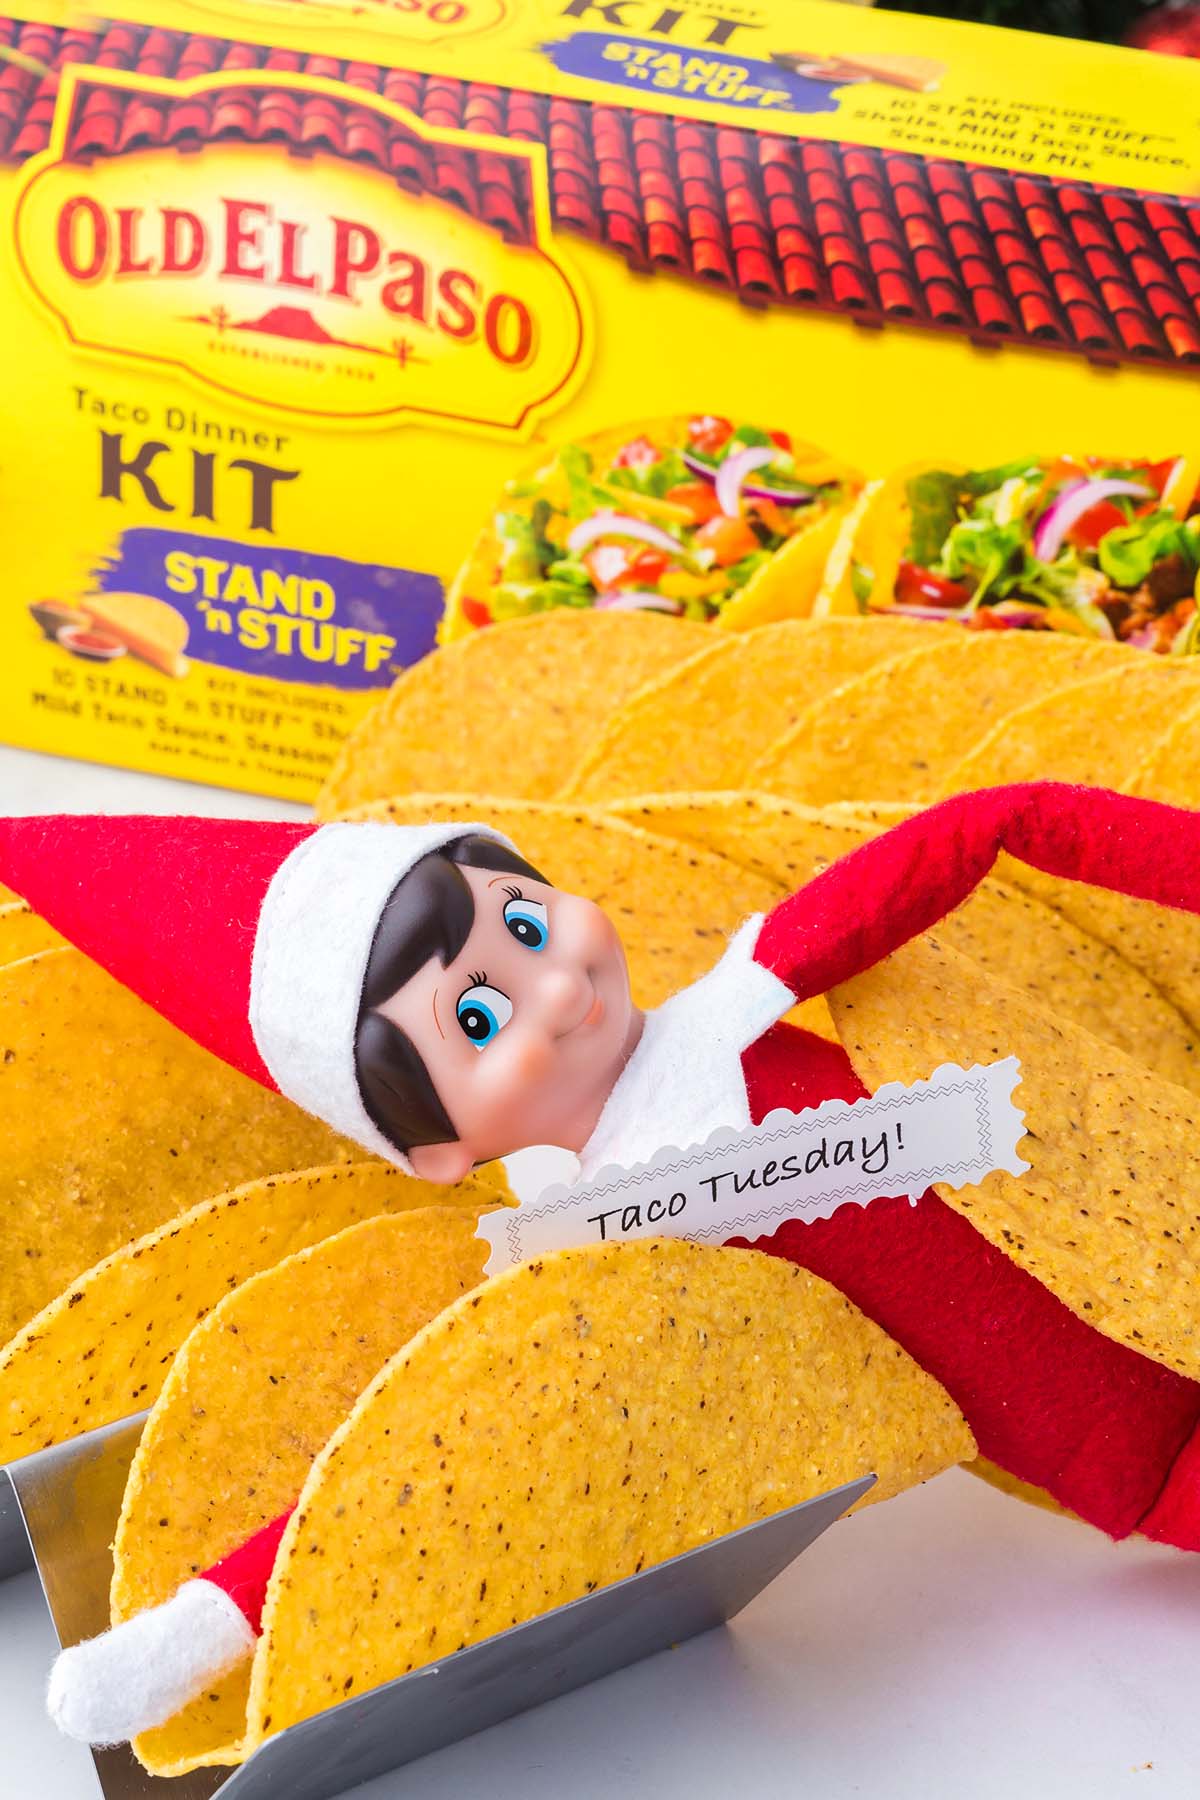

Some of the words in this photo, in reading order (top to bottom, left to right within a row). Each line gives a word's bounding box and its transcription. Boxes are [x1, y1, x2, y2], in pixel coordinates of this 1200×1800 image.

[561, 0, 768, 46] KIT
[601, 41, 750, 84] STAND
[928, 102, 1021, 125] STAND
[890, 128, 1036, 164] Seasoning
[1047, 151, 1093, 170] Mix
[959, 121, 1018, 141] Mild
[1030, 132, 1091, 151] Taco
[73, 386, 150, 425] Taco
[165, 406, 291, 453] Dinner
[98, 427, 302, 535] KIT
[163, 550, 337, 622] STAND
[85, 673, 169, 709] STAND
[587, 1192, 687, 1240] Taco
[699, 1122, 905, 1202] Tuesday!
